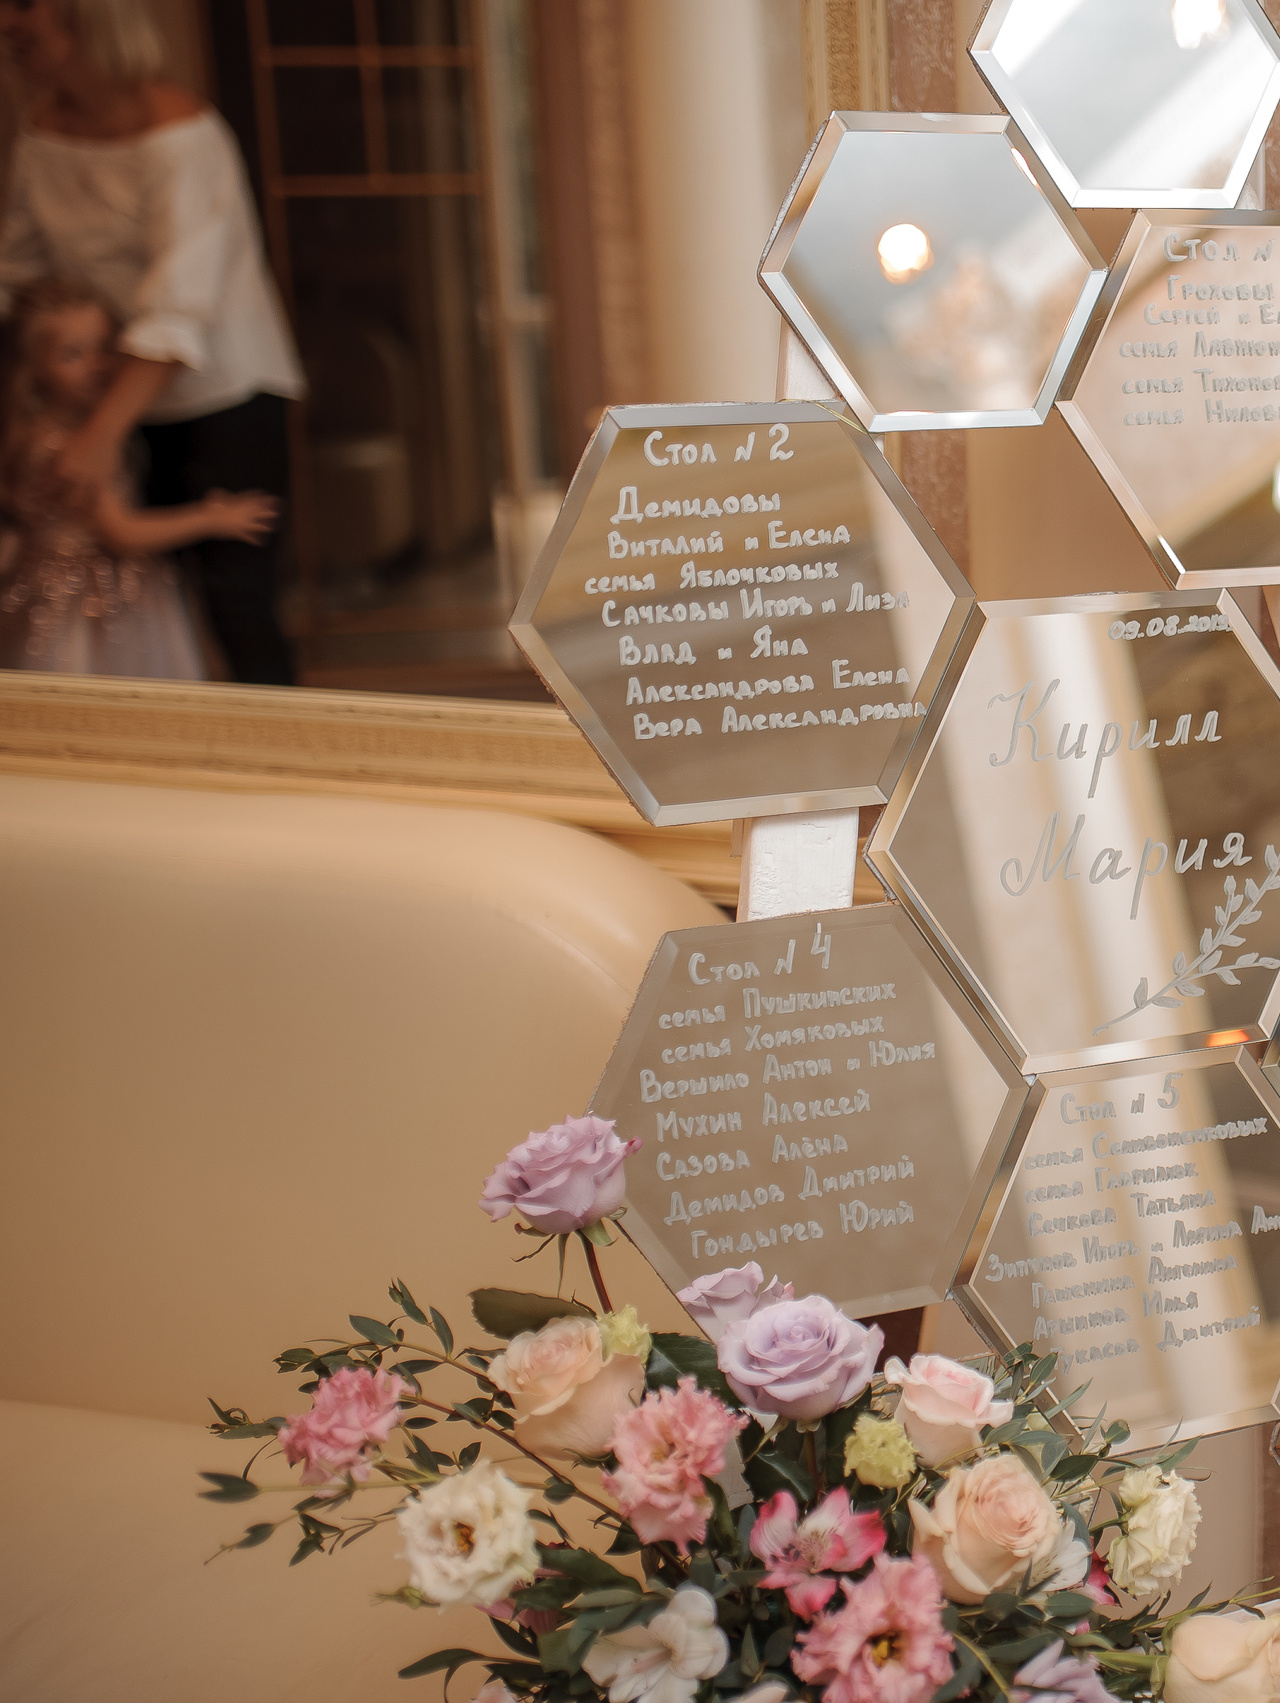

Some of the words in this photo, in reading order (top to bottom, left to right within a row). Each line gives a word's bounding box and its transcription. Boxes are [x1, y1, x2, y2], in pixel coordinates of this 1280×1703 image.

[1164, 232, 1240, 262] Стол
[1144, 303, 1220, 325] Сергей
[1238, 313, 1251, 324] и
[1119, 340, 1178, 358] семья
[1121, 375, 1184, 394] семья
[1123, 408, 1184, 426] семья
[644, 430, 716, 466] Стол
[769, 423, 794, 461] 2
[610, 486, 780, 524] Демидовы
[607, 530, 723, 559] Виталий
[744, 536, 758, 551] и
[768, 521, 851, 549] Елена
[584, 573, 655, 594] семья
[680, 560, 838, 589] Яблочковых
[601, 600, 729, 627] Сачковы
[739, 588, 813, 619] Игорь
[821, 598, 836, 613] и
[846, 582, 909, 612] Лиза
[619, 635, 697, 665] Влад
[718, 646, 733, 660] и
[750, 625, 808, 658] Яна
[626, 677, 814, 706] Александрова
[831, 659, 910, 689] Елена
[633, 712, 702, 740] Вера
[721, 701, 927, 733] Александровна
[987, 678, 1222, 799] Кирилл
[1000, 811, 1253, 920] Мария
[688, 952, 760, 985] Стол
[810, 922, 831, 969] 4
[658, 1005, 726, 1030] семья
[743, 983, 896, 1018] Пушкинских
[661, 1038, 732, 1064] семья
[744, 1016, 885, 1052] Хомяковых
[640, 1069, 749, 1103] Вершило
[763, 1054, 832, 1084] Антон
[846, 1058, 860, 1072] и
[869, 1039, 936, 1068] Юлия
[656, 1109, 743, 1143] Мухин
[762, 1088, 871, 1127] Алексей
[1059, 1092, 1117, 1126] Стол
[1156, 1071, 1183, 1110] 5
[656, 1149, 750, 1182] Сазова
[772, 1134, 849, 1164] Алёна
[1024, 1146, 1084, 1171] семья
[663, 1184, 785, 1227] Демидов
[798, 1155, 915, 1201] Дмитрий
[1024, 1180, 1084, 1204] семья
[1130, 1189, 1217, 1219] Татьяна
[690, 1220, 824, 1260] Гондырев
[839, 1200, 914, 1235] Юрий
[1081, 1235, 1141, 1265] Игорь
[1151, 1241, 1164, 1252] и
[1141, 1290, 1199, 1318] Илья
[1156, 1305, 1261, 1352] Дмитрий
